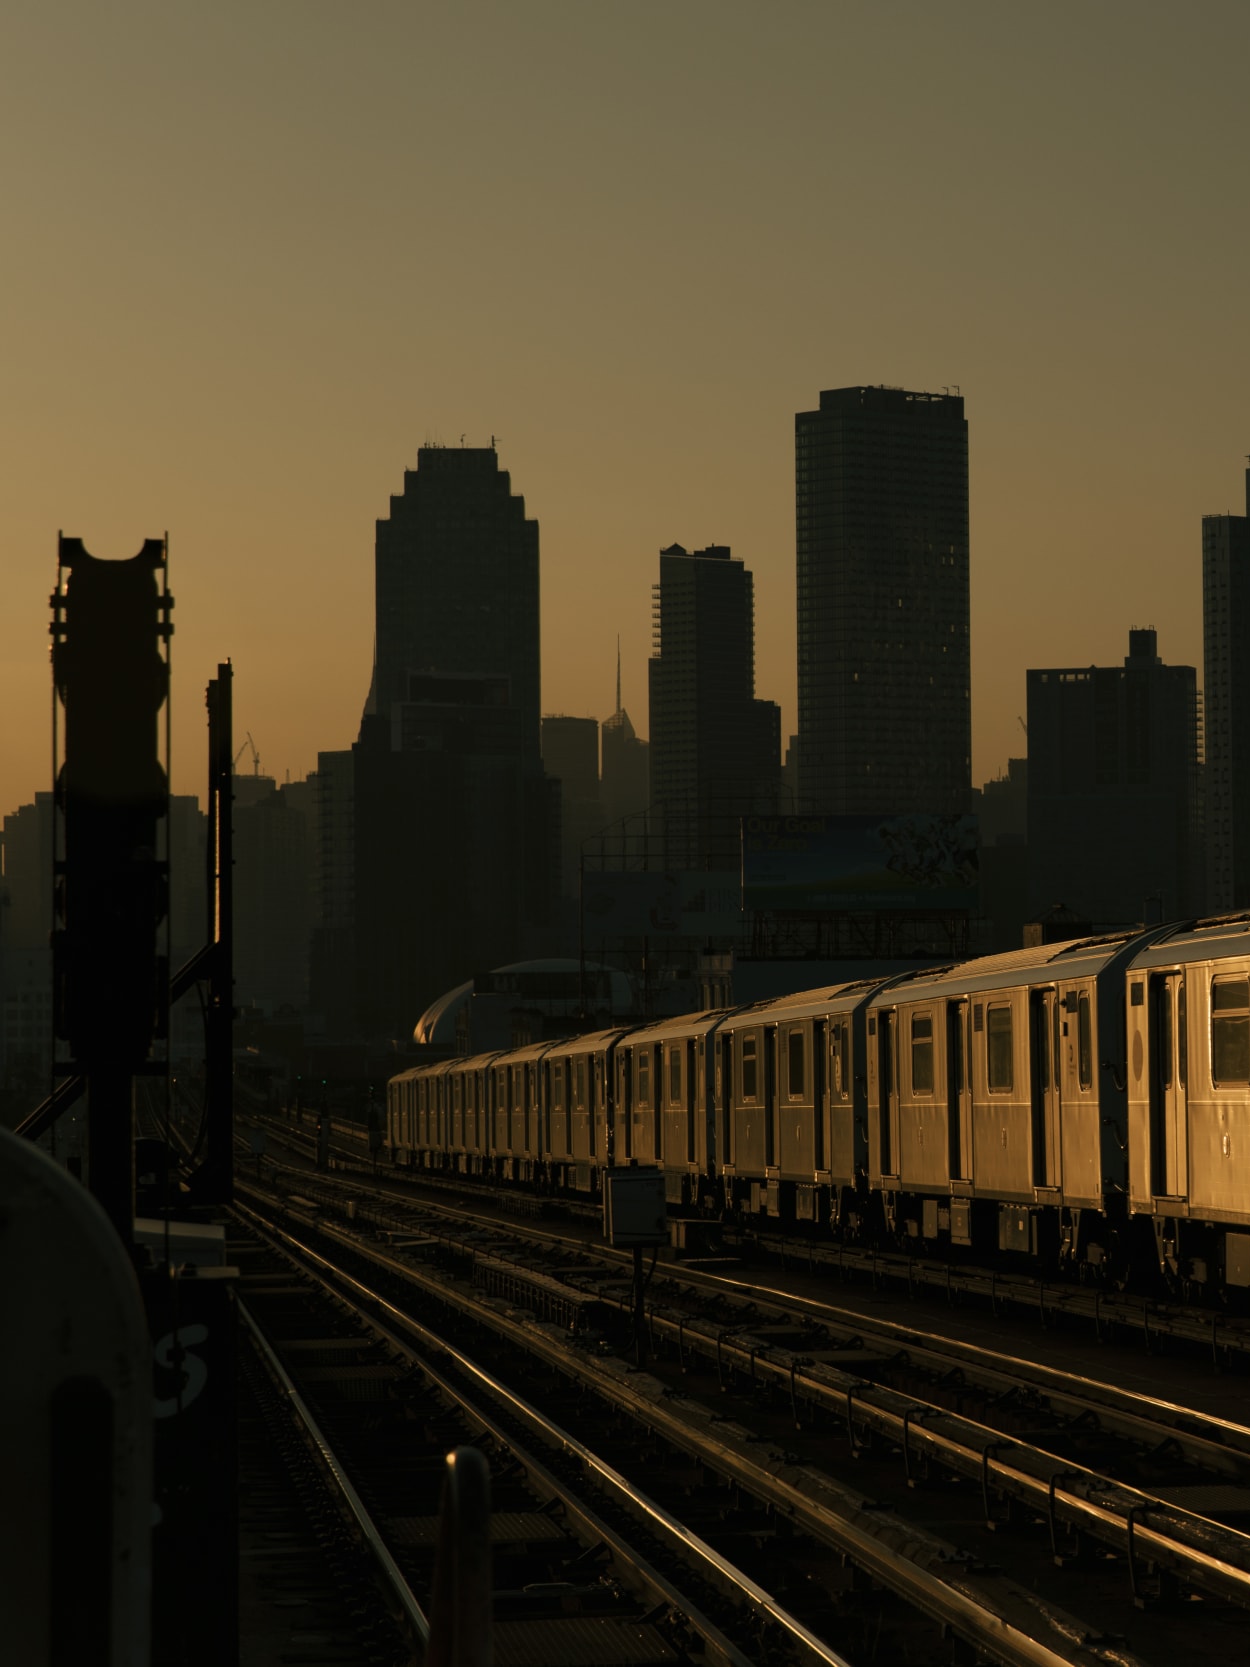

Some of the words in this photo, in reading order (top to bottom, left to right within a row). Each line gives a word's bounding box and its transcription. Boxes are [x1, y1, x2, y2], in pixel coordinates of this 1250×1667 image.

[747, 817, 781, 833] Our
[785, 817, 825, 833] Goal
[767, 834, 807, 849] Zero
[154, 1323, 208, 1418] S
